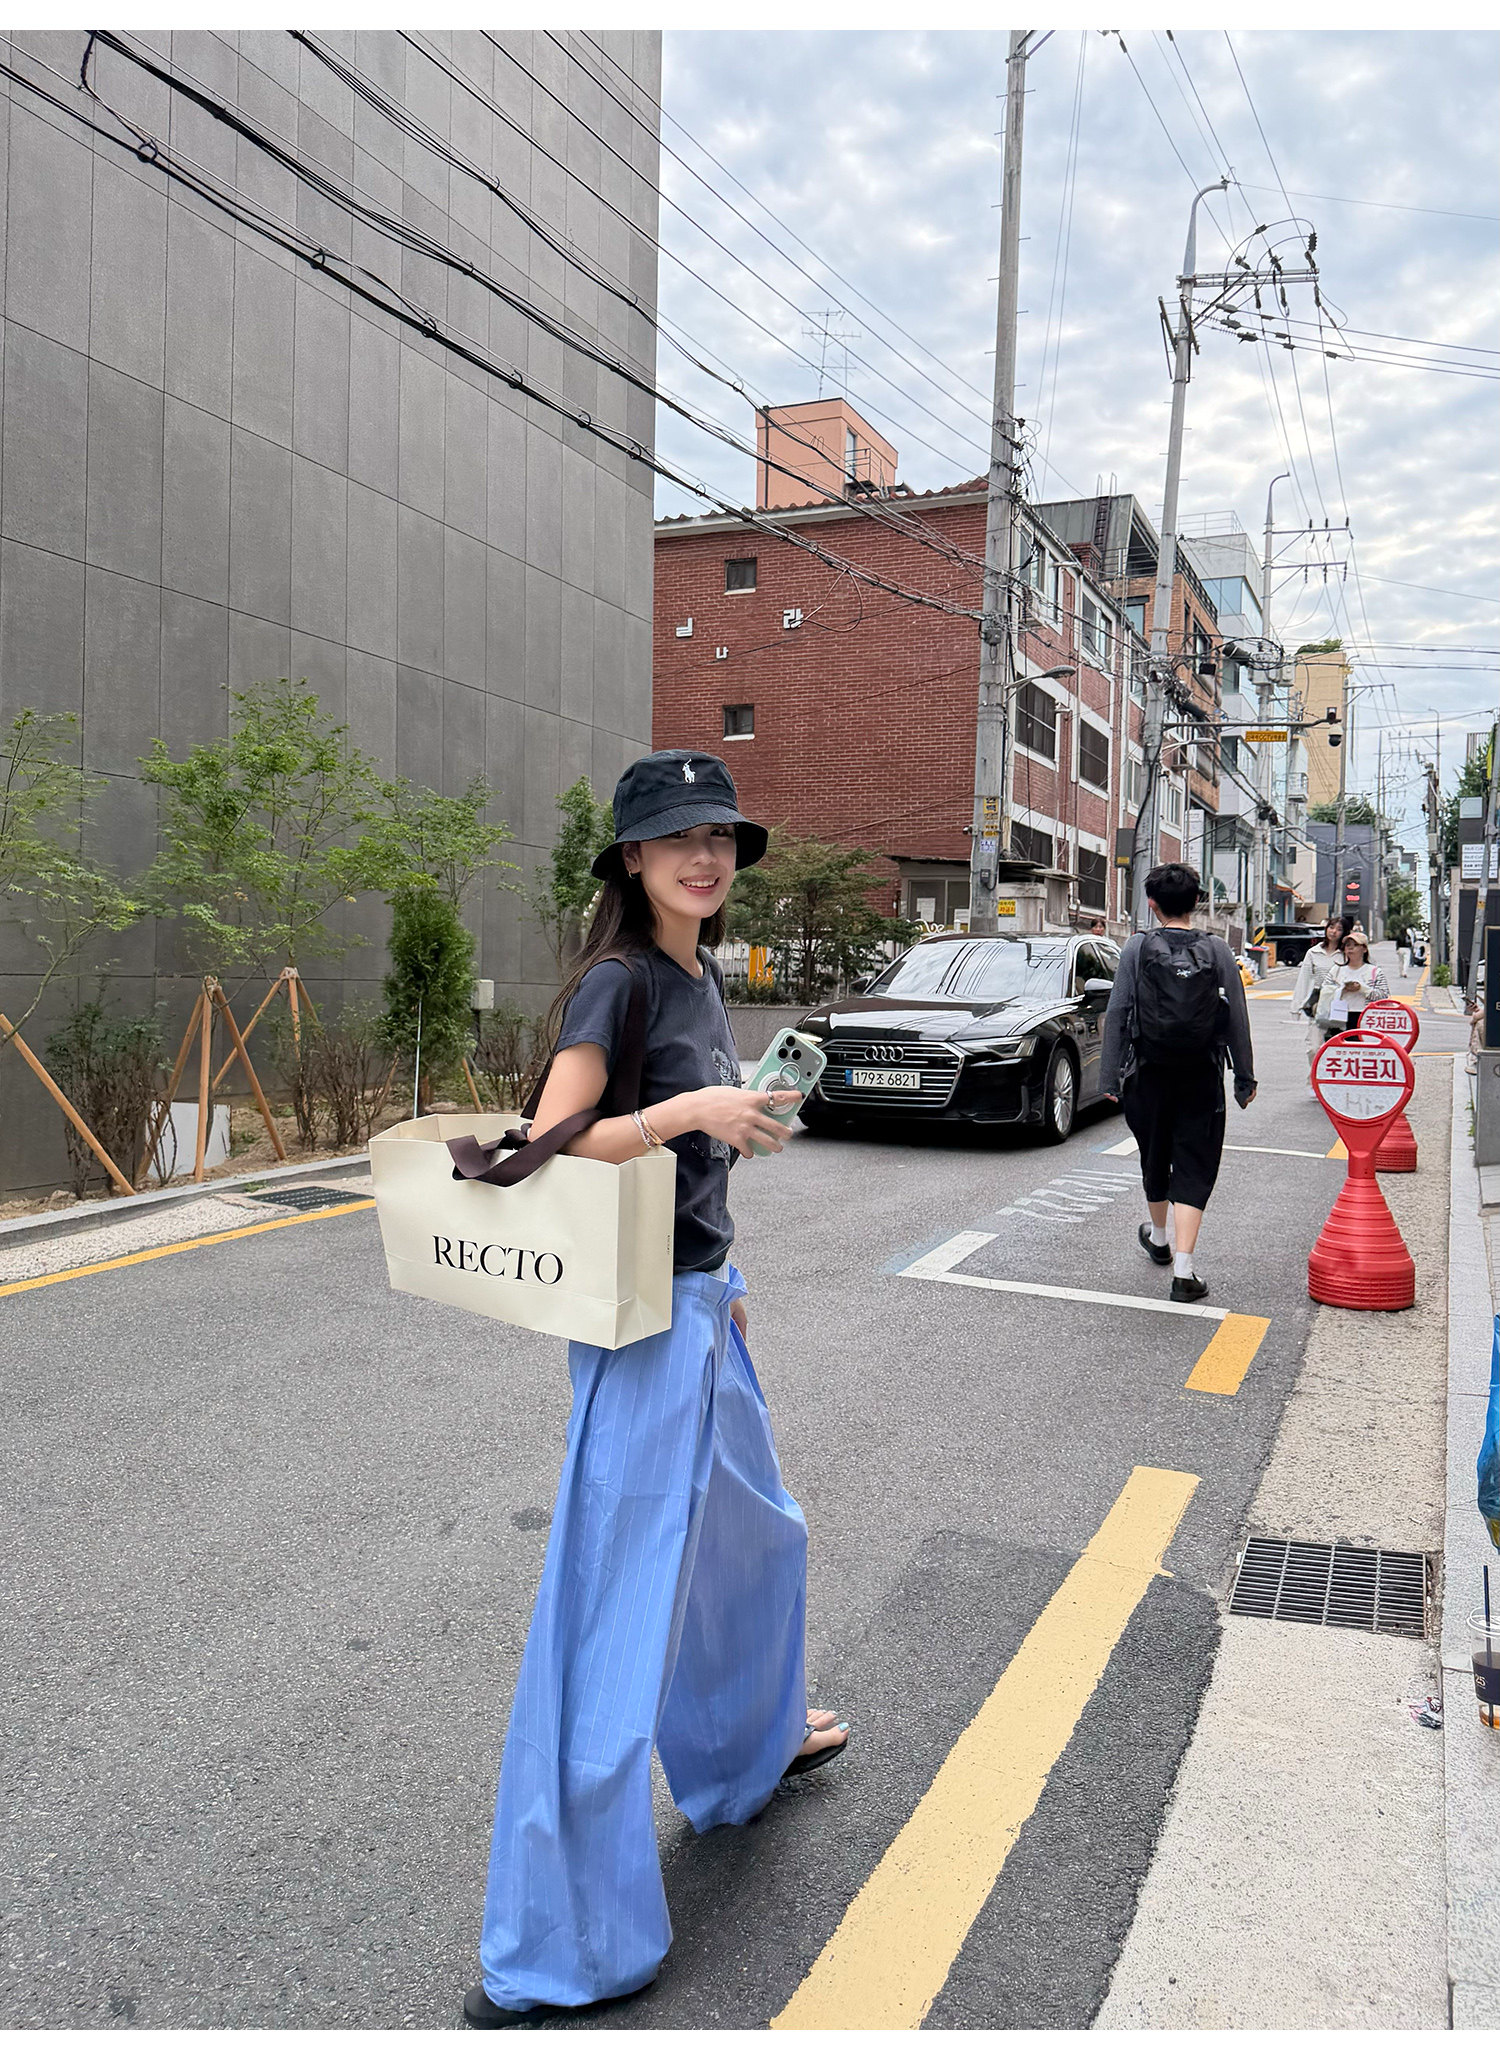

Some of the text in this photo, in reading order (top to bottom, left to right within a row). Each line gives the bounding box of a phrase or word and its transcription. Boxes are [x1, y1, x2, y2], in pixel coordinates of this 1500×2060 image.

[1366, 1016, 1407, 1030] 주차금지
[1325, 1057, 1397, 1080] 주차금지
[855, 1072, 916, 1087] 179조 6821
[432, 1235, 564, 1285] RECTO
